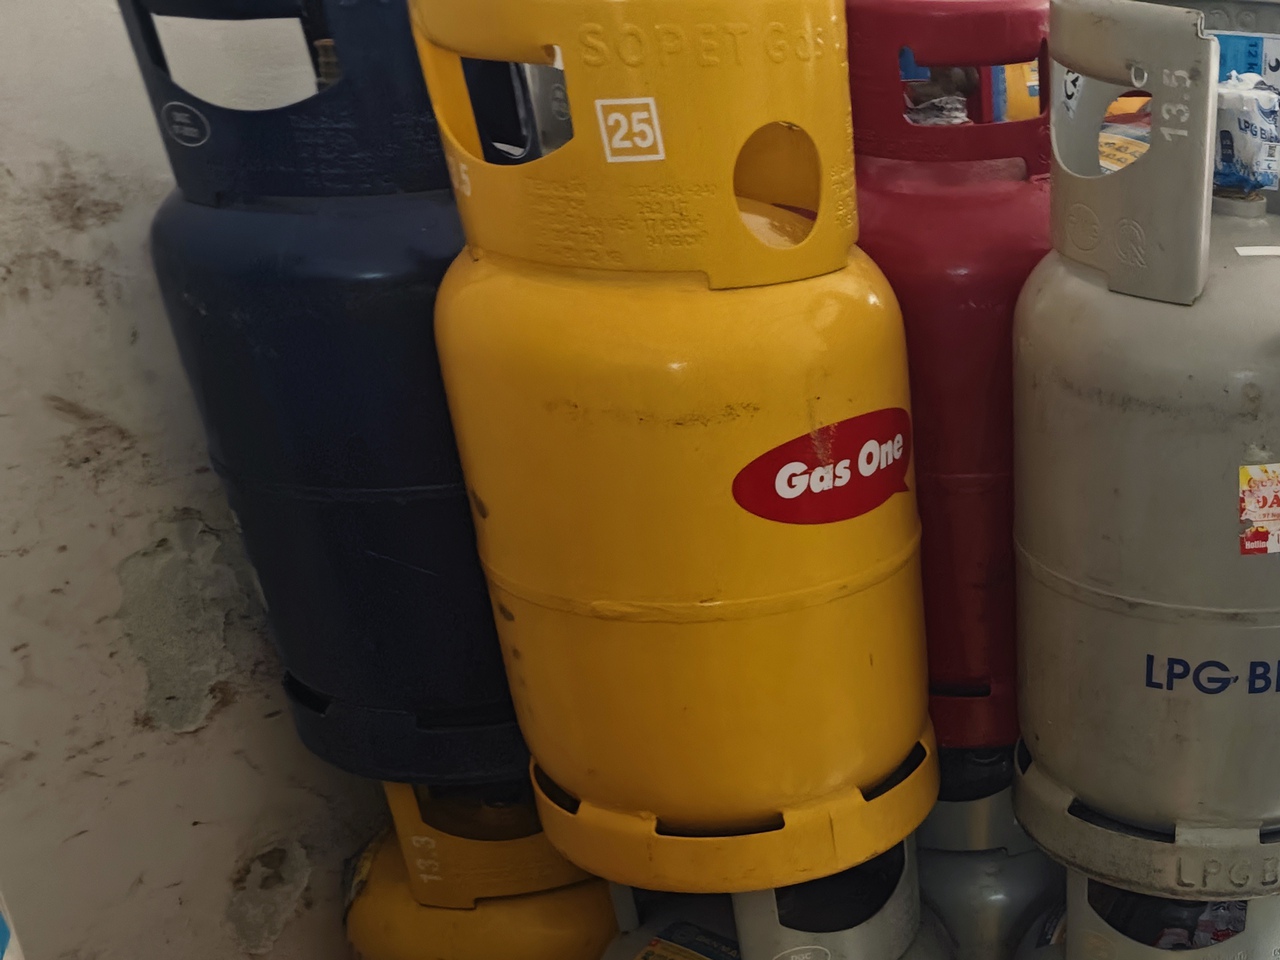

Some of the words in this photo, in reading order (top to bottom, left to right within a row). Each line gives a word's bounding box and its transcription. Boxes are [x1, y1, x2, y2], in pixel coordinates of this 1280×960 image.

[578, 22, 749, 68] SOPET
[1160, 69, 1191, 142] 13.5
[607, 111, 654, 148] 25
[1237, 117, 1259, 138] LPG
[775, 459, 851, 499] Gas
[858, 433, 904, 477] One
[1145, 654, 1239, 695] LPG
[1175, 856, 1251, 888] LPG
